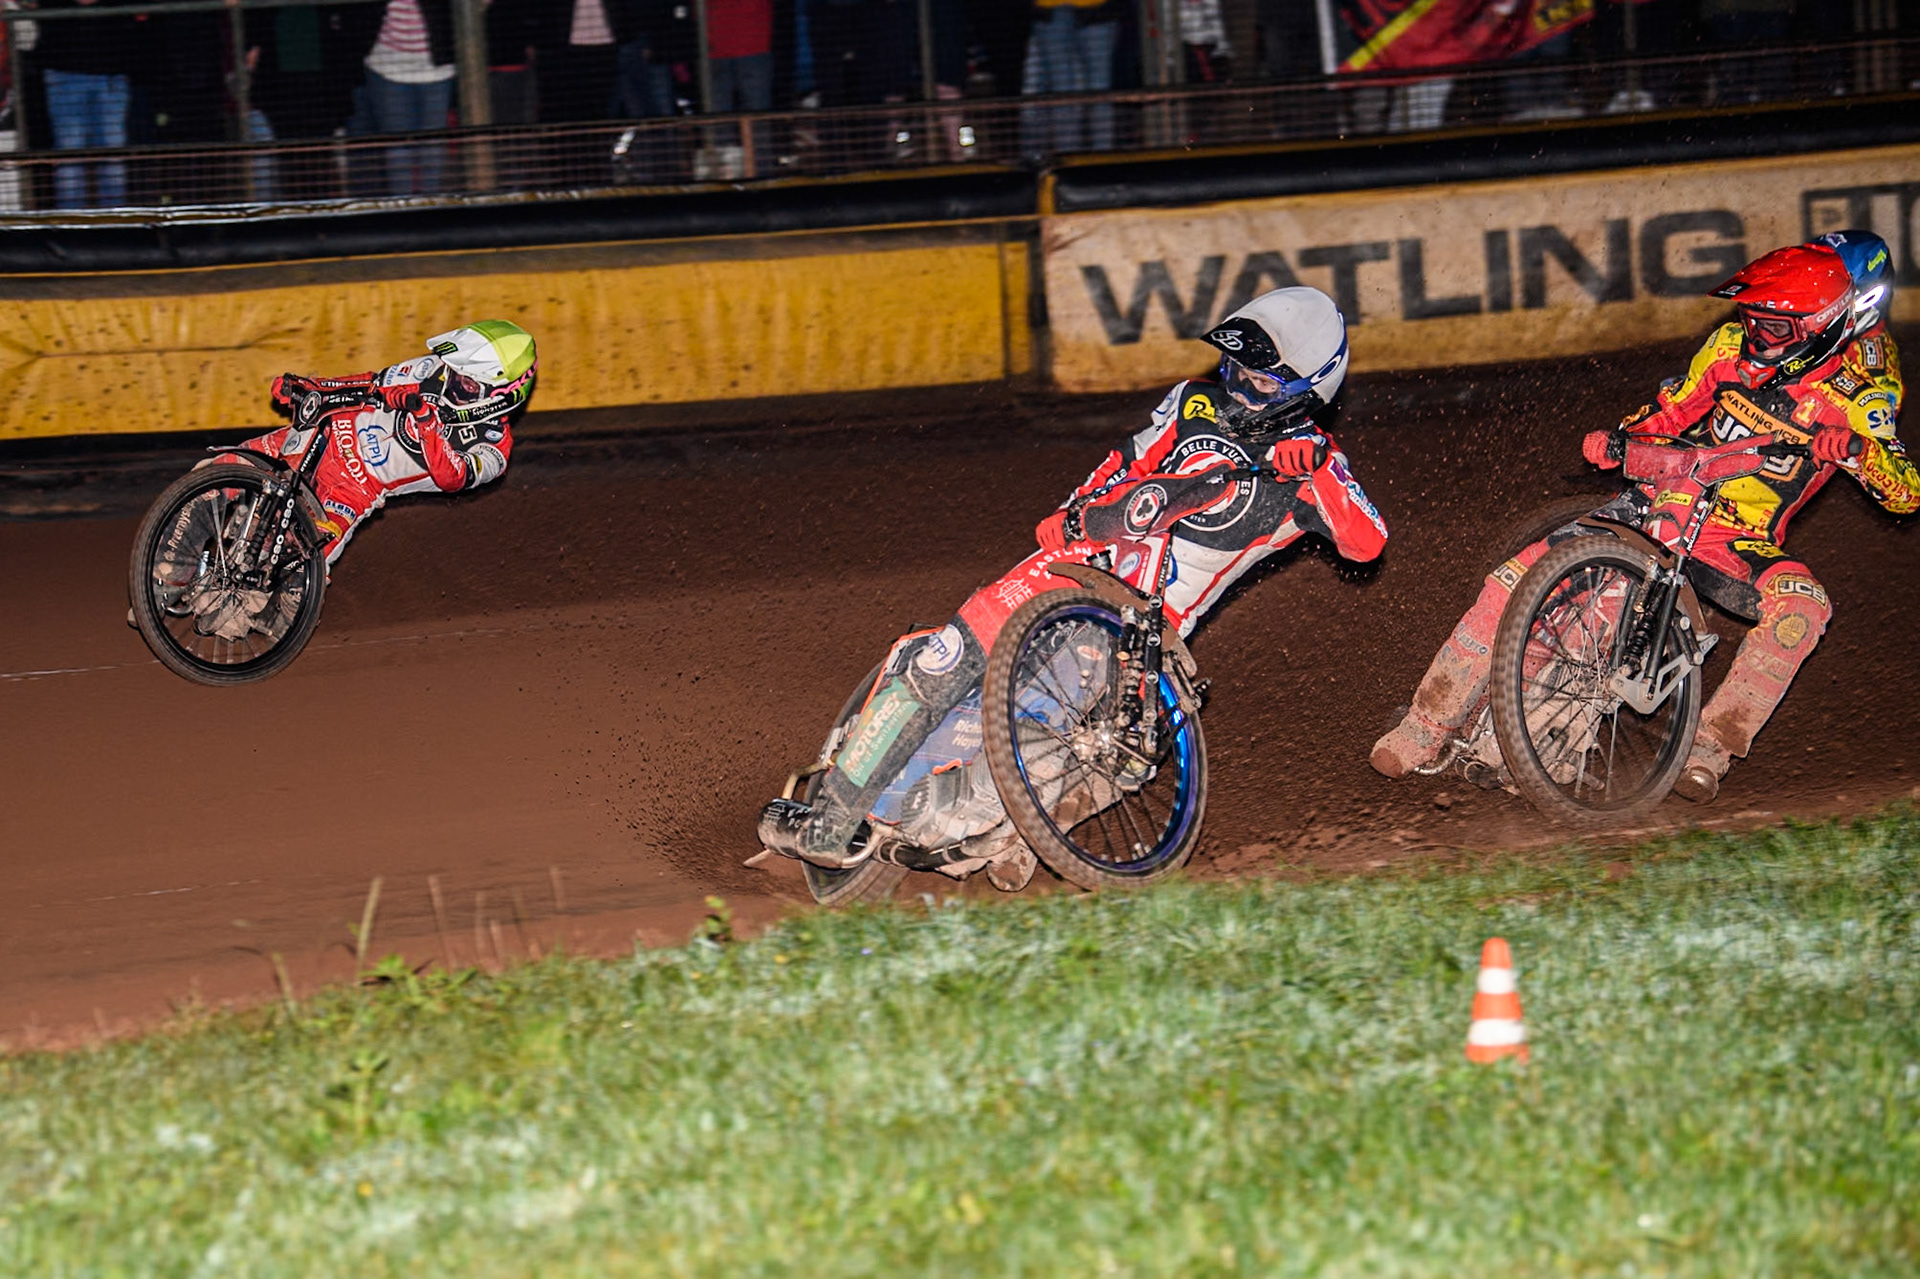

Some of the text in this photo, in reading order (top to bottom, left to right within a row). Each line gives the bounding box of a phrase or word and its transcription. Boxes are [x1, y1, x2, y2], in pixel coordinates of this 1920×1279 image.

[1081, 208, 1747, 345] WATLING
[1835, 376, 1856, 391] CB
[1726, 392, 1774, 431] WATLING
[366, 433, 381, 459] ATPI
[1180, 440, 1218, 457] BELLE
[1221, 445, 1243, 464] VUE
[1779, 580, 1827, 604] JCB
